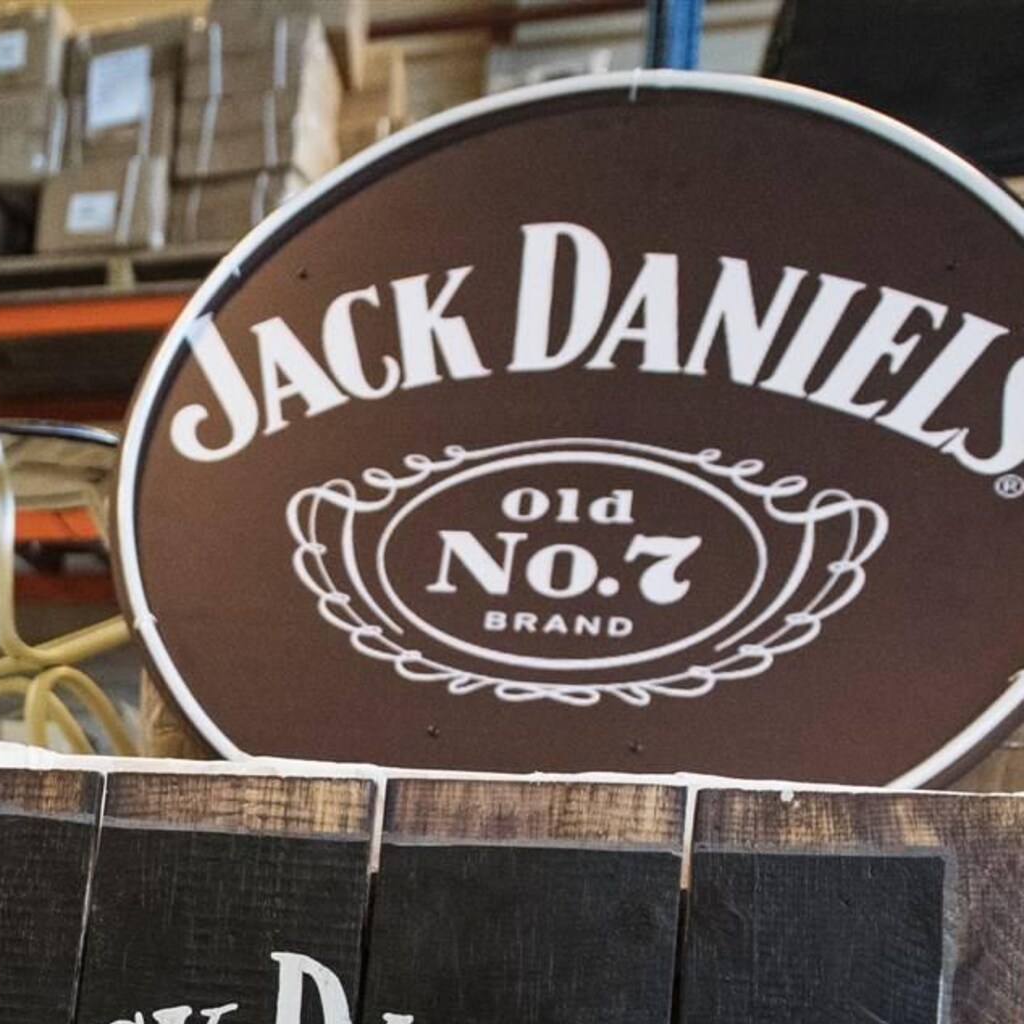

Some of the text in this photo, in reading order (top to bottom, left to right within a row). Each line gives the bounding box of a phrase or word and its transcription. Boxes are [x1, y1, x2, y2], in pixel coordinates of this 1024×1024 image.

[170, 265, 492, 463] JACK
[501, 487, 634, 524] Old
[483, 611, 633, 637] BRAND
